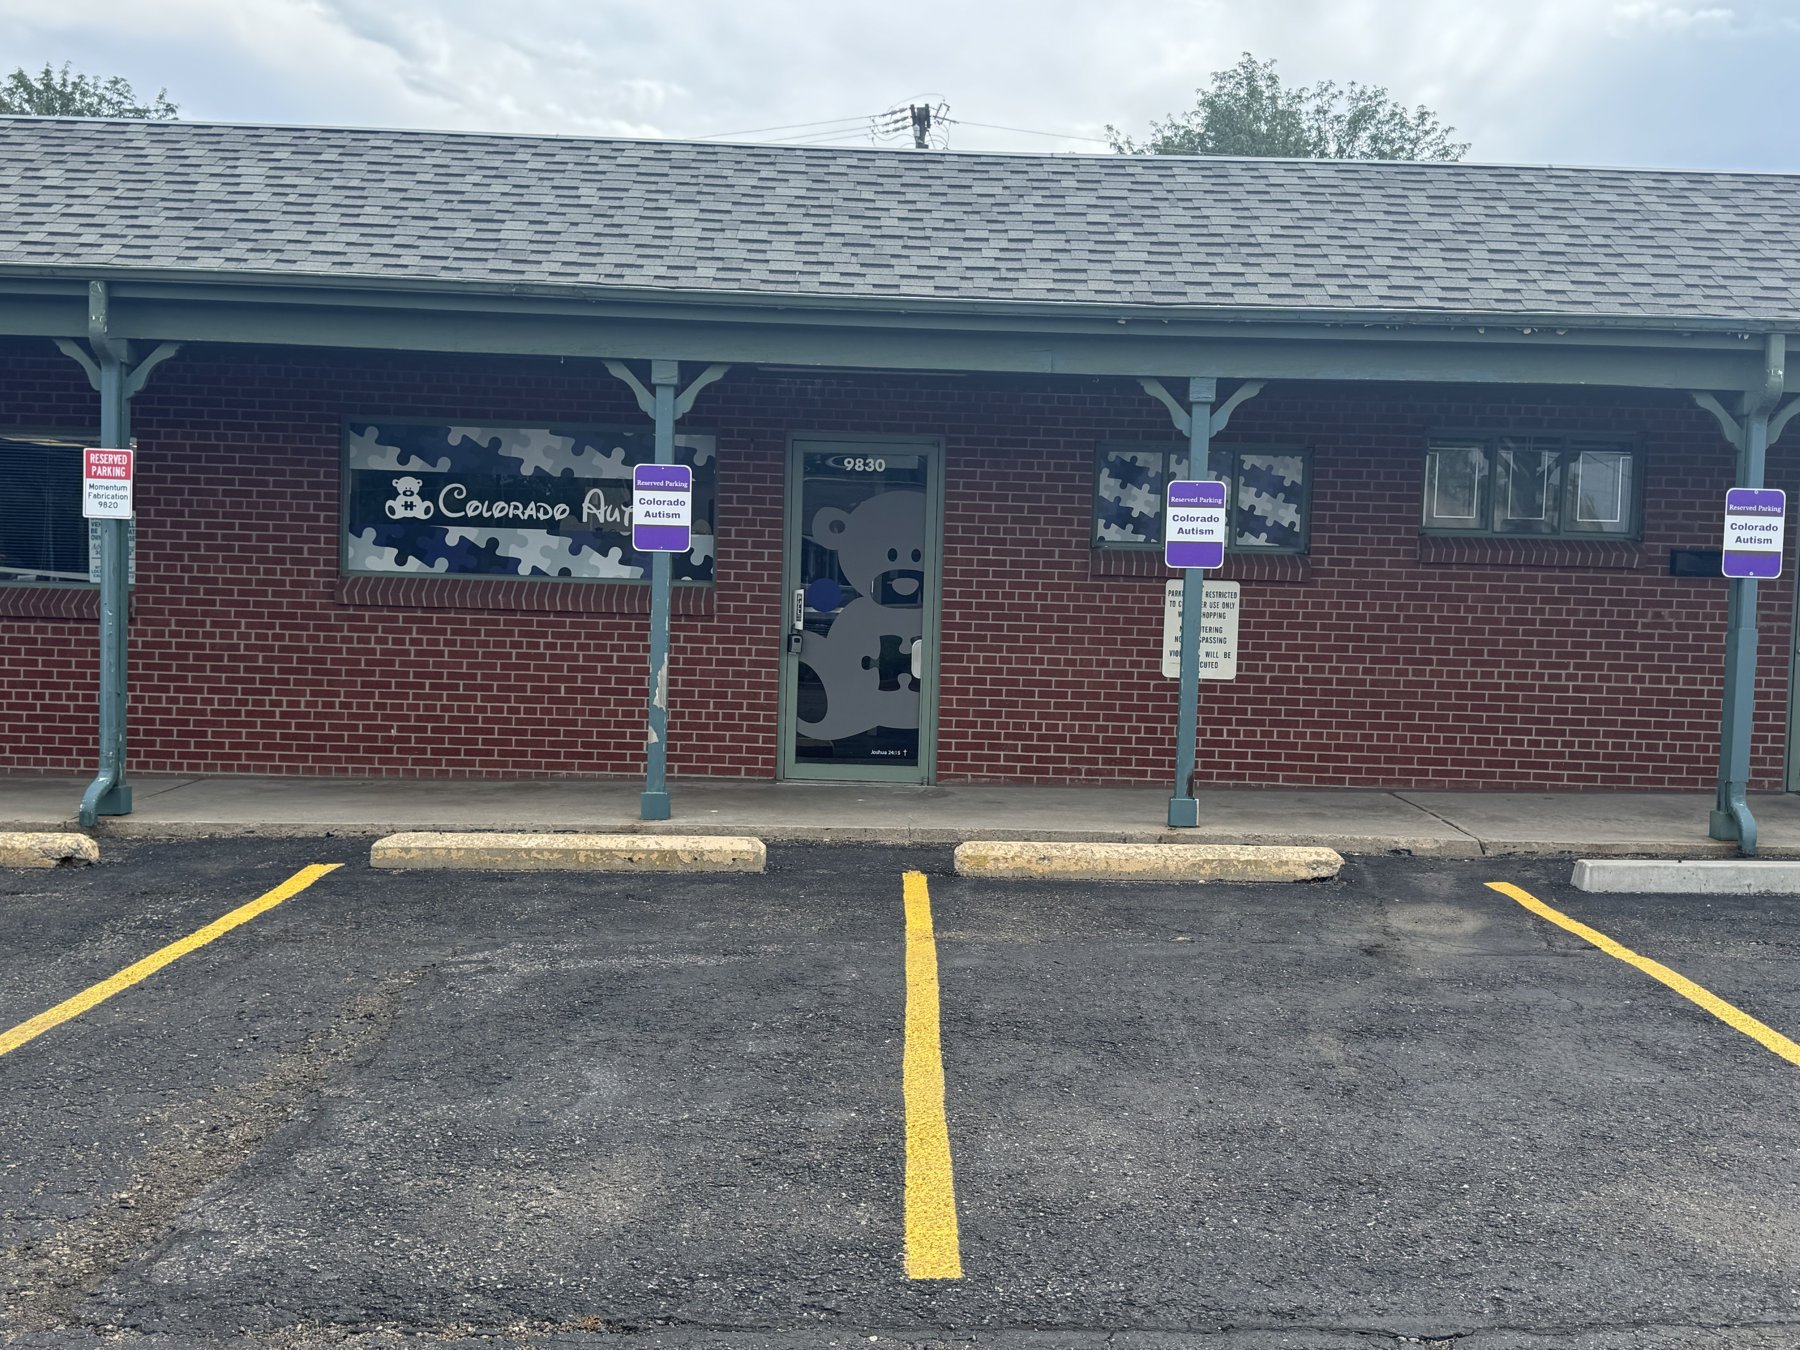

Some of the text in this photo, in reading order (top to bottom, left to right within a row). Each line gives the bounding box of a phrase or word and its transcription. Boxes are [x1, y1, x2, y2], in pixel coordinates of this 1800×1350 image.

[90, 453, 127, 465] RESERVED
[843, 458, 886, 472] 9830
[91, 465, 126, 477] PARKING
[88, 483, 128, 492] Momentum
[665, 481, 688, 489] Parking
[88, 491, 129, 501] Fabrication
[97, 501, 119, 509] 9820
[638, 497, 686, 506] Colorado
[1199, 497, 1223, 505] Parking
[582, 488, 633, 527] AUT
[1758, 505, 1782, 513] Parking
[643, 510, 681, 519] Autism
[1172, 514, 1220, 523] Colorado
[1177, 527, 1214, 535] Autism
[1730, 522, 1779, 532] Colorado
[1734, 535, 1773, 545] Autism
[1205, 591, 1238, 599] RESTRICTED
[1169, 600, 1176, 608] TO
[1222, 602, 1236, 610] ONLY
[1201, 612, 1227, 620] HOPPING
[1202, 626, 1223, 634] TERING
[1205, 651, 1232, 659] WILL BE
